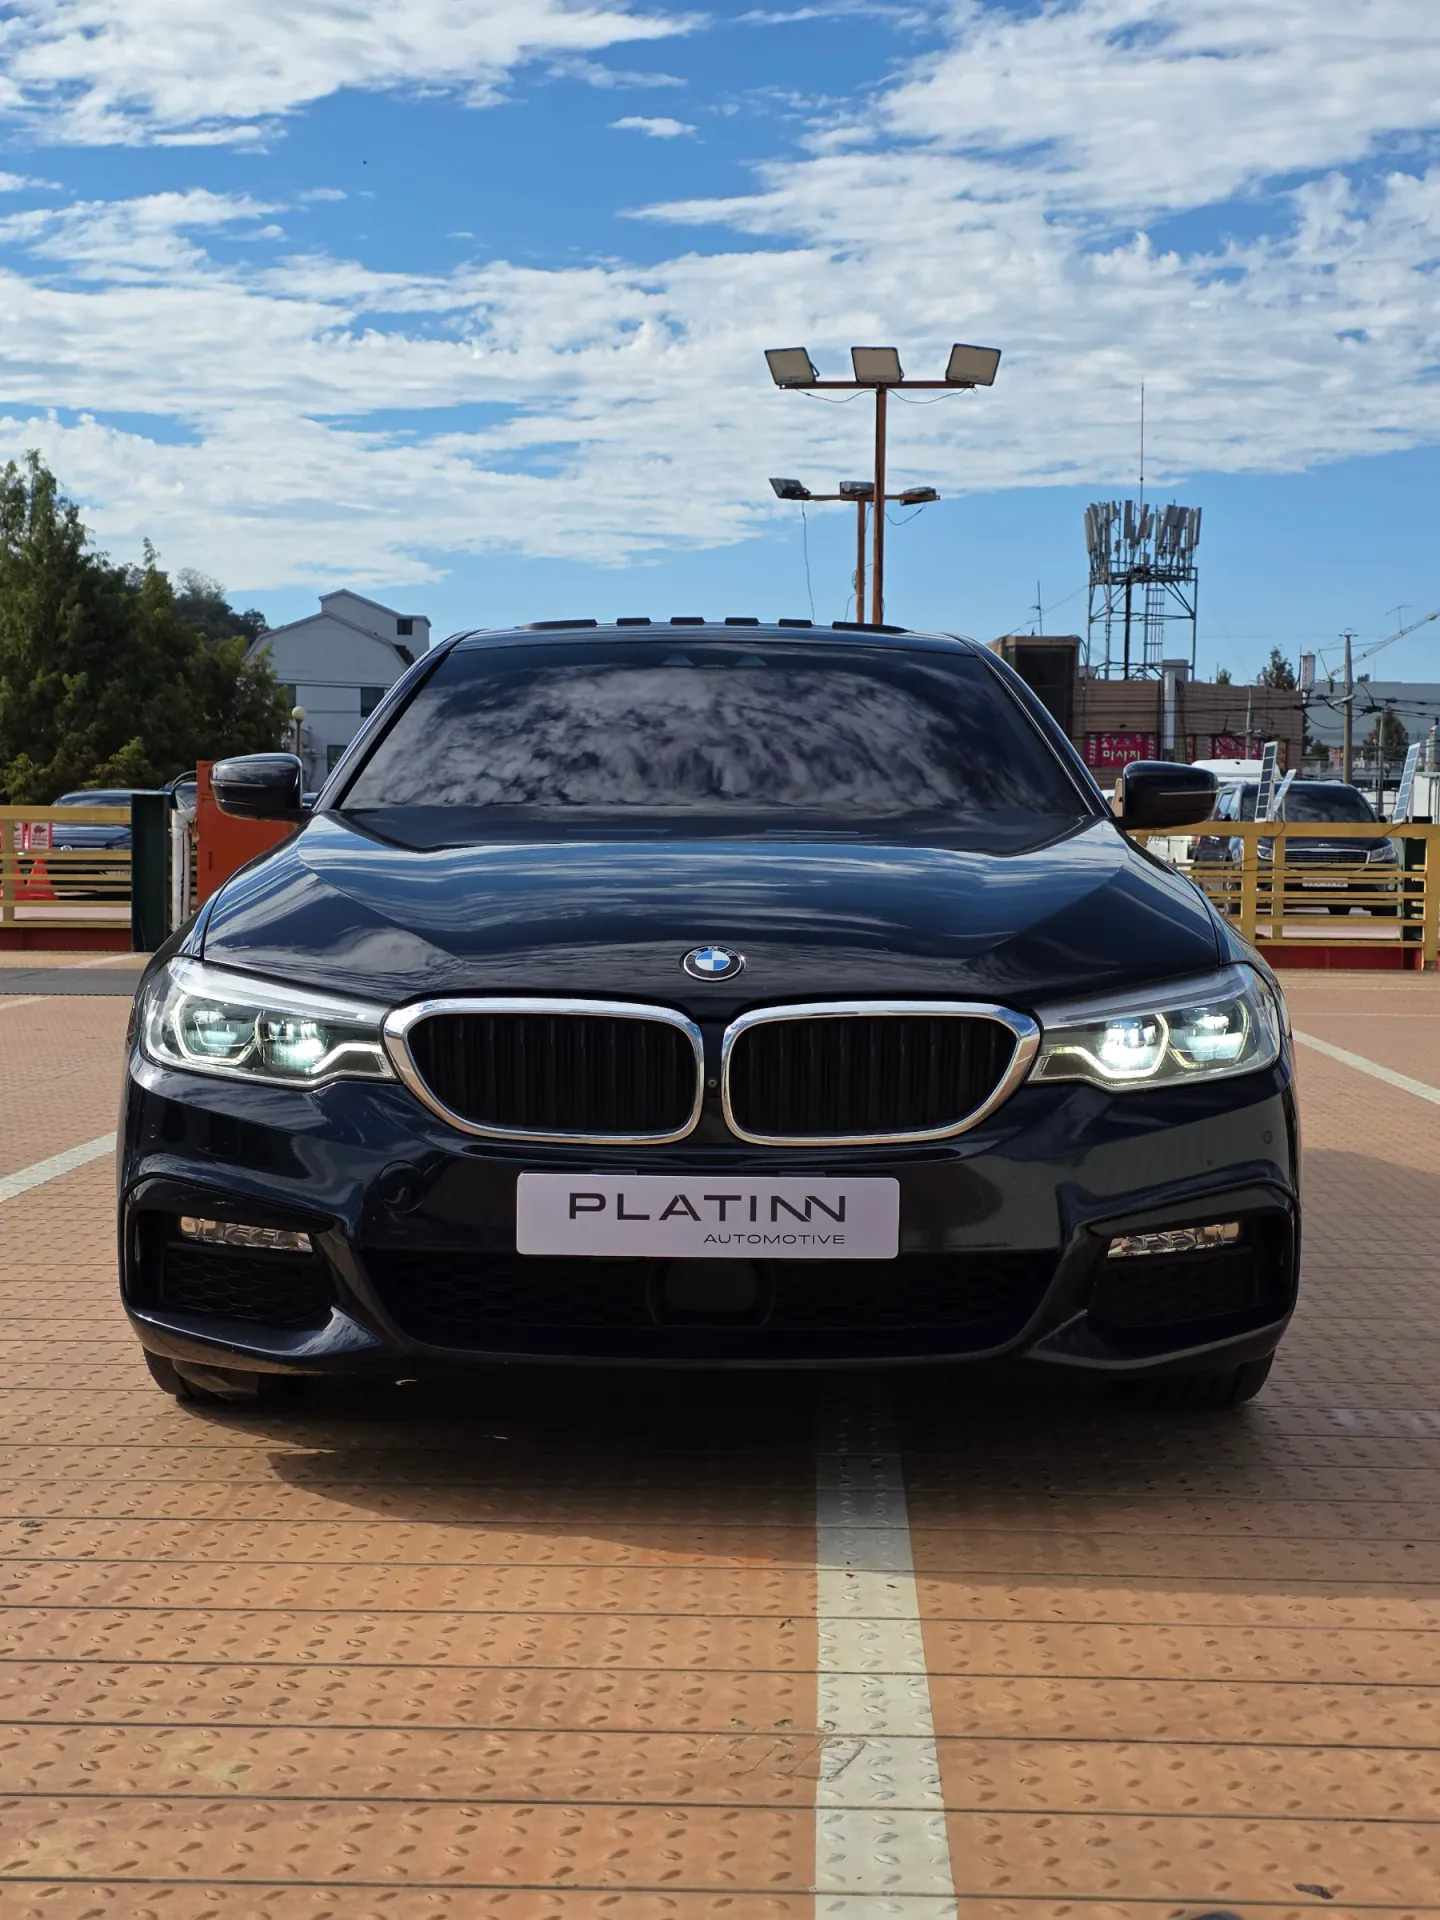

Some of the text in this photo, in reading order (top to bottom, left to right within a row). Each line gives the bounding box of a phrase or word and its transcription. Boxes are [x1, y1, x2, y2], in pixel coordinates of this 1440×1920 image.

[1103, 750, 1141, 762] 마사지
[569, 1192, 846, 1223] PLATINN
[703, 1233, 846, 1245] AUTOMOTIVE
